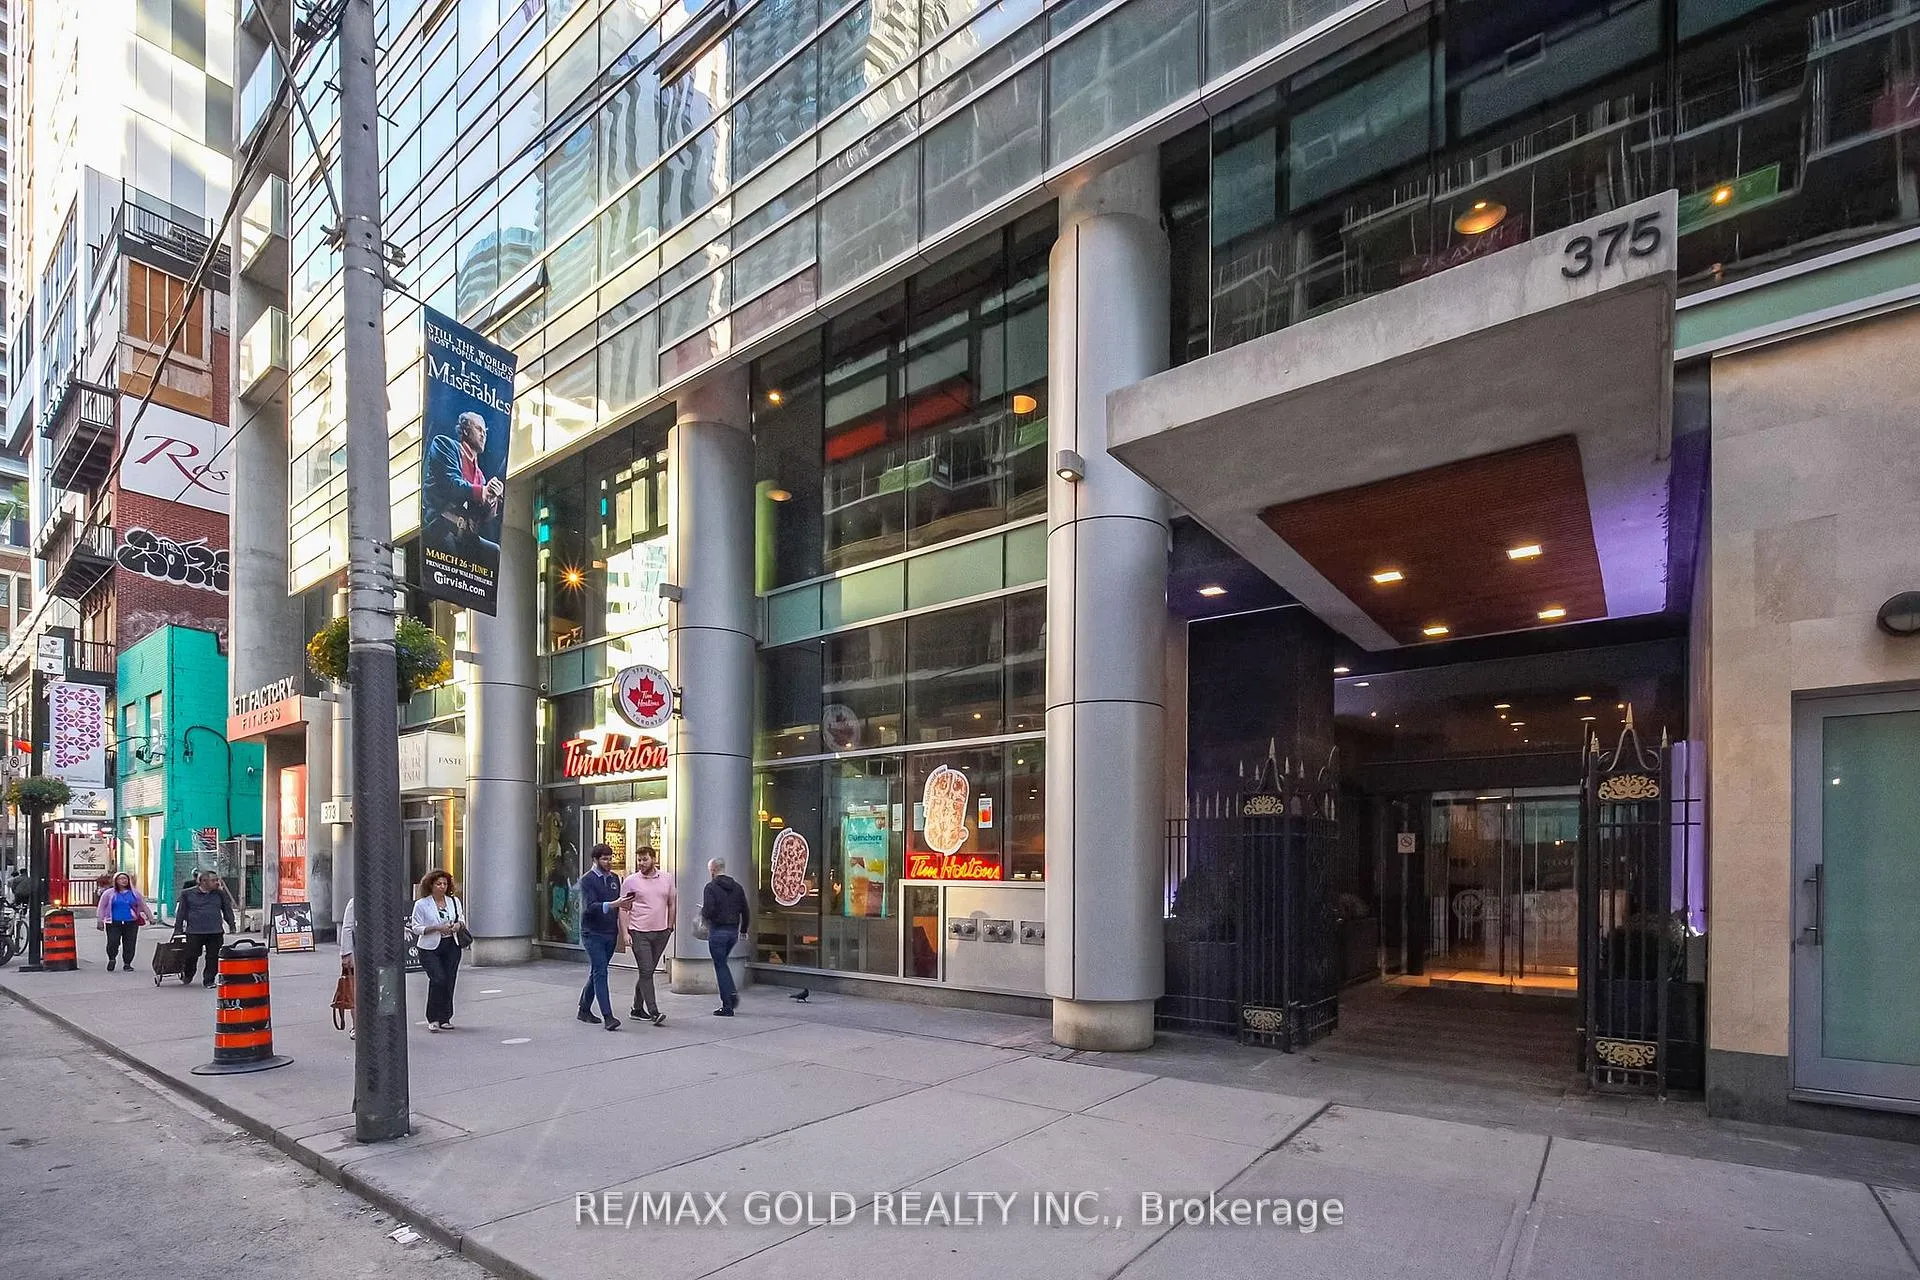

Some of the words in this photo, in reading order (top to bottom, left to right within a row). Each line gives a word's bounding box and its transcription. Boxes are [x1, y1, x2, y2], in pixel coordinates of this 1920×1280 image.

[1561, 210, 1661, 278] 375
[426, 320, 454, 344] STILL
[456, 337, 475, 354] THE
[477, 349, 514, 376] WORLD'S
[427, 333, 449, 349] MOST
[451, 345, 482, 367] POPULAR
[484, 363, 512, 384] MUSICAL
[427, 353, 512, 416] Misérables
[460, 360, 481, 384] Les
[425, 547, 458, 566] MARCH
[459, 559, 468, 569] 26
[490, 570, 494, 578] 1
[425, 558, 450, 572] PRINCESS
[451, 567, 458, 575] OF
[233, 693, 247, 716] FIT
[249, 675, 294, 711] FACTORY
[637, 698, 660, 707] Hortons
[641, 690, 653, 699] Tim
[242, 706, 281, 730] FITNESS
[632, 713, 663, 726] TORONTO
[562, 738, 594, 778] Tim
[598, 732, 669, 773] Horton
[325, 804, 337, 819] 373
[910, 855, 938, 878] Tim
[940, 853, 1000, 879] Hortons
